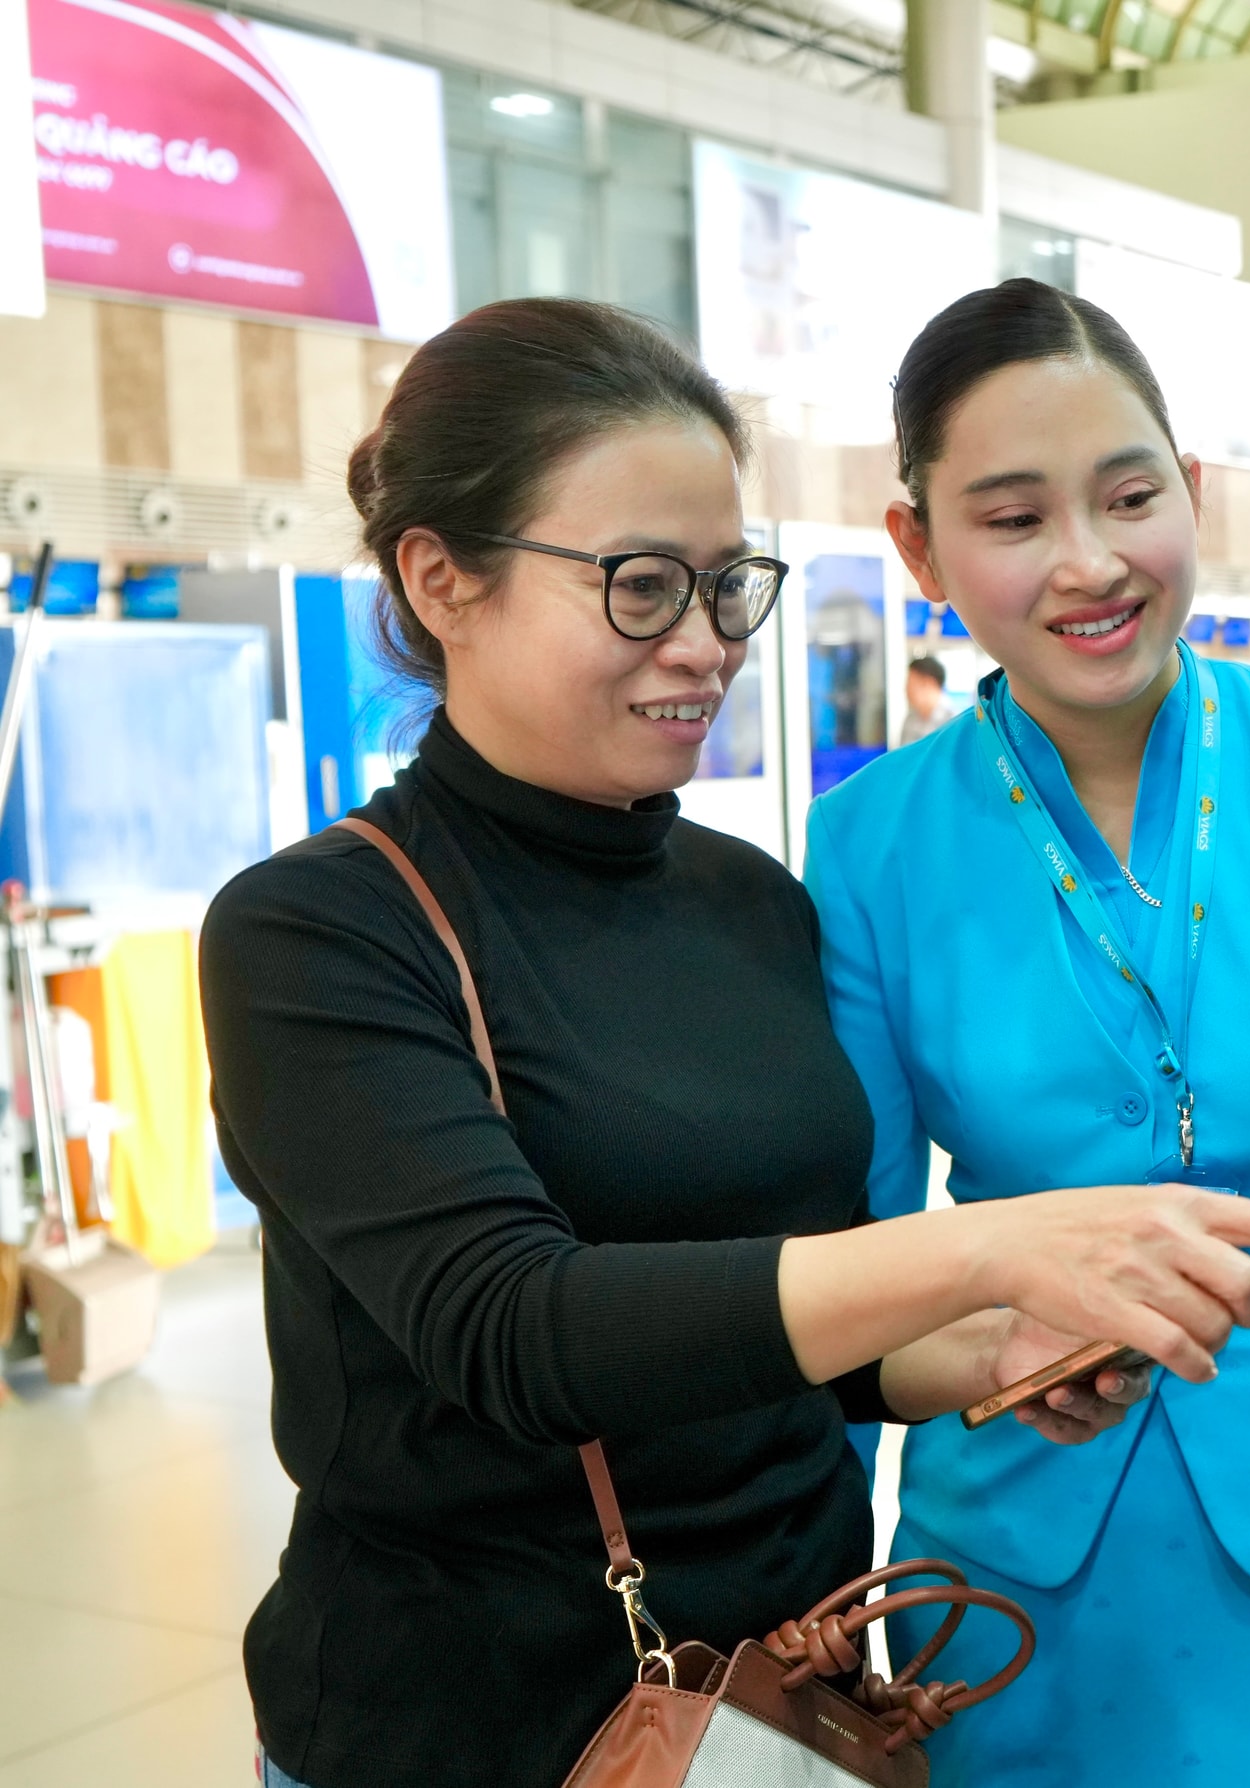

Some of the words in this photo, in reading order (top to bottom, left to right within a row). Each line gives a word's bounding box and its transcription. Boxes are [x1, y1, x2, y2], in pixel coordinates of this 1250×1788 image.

[1201, 715, 1214, 748] VIAGS
[996, 755, 1017, 788] VIAGS
[1196, 816, 1210, 850] VIAGS
[1043, 841, 1067, 878] VIAGS
[1097, 933, 1121, 968] VIAGS
[1191, 923, 1201, 960] VIAGS
